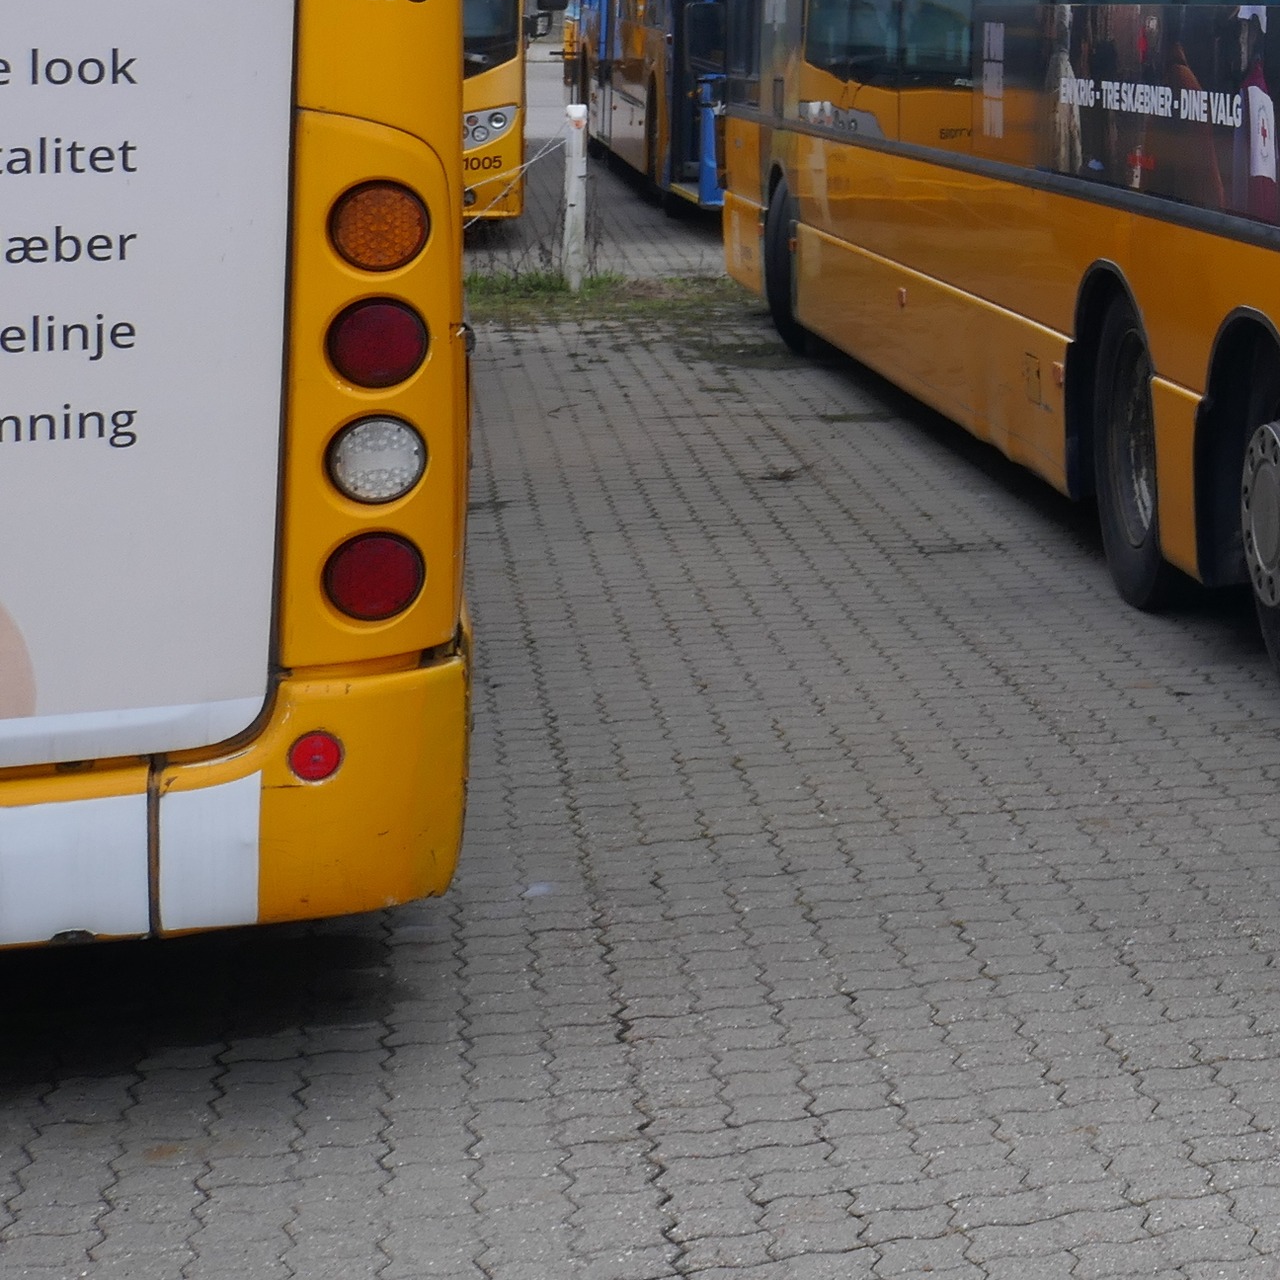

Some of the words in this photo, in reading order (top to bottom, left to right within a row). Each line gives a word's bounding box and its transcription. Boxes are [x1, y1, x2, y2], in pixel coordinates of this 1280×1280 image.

[31, 47, 138, 85] look
[1073, 78, 1095, 108] KRIG
[1101, 80, 1120, 111] TRE
[1121, 82, 1172, 117] SKÆBNER
[1180, 88, 1208, 122] DINE
[1209, 91, 1242, 128] VALG
[463, 156, 503, 170] 1005
[5, 226, 138, 264] æber
[0, 313, 136, 361] elinje
